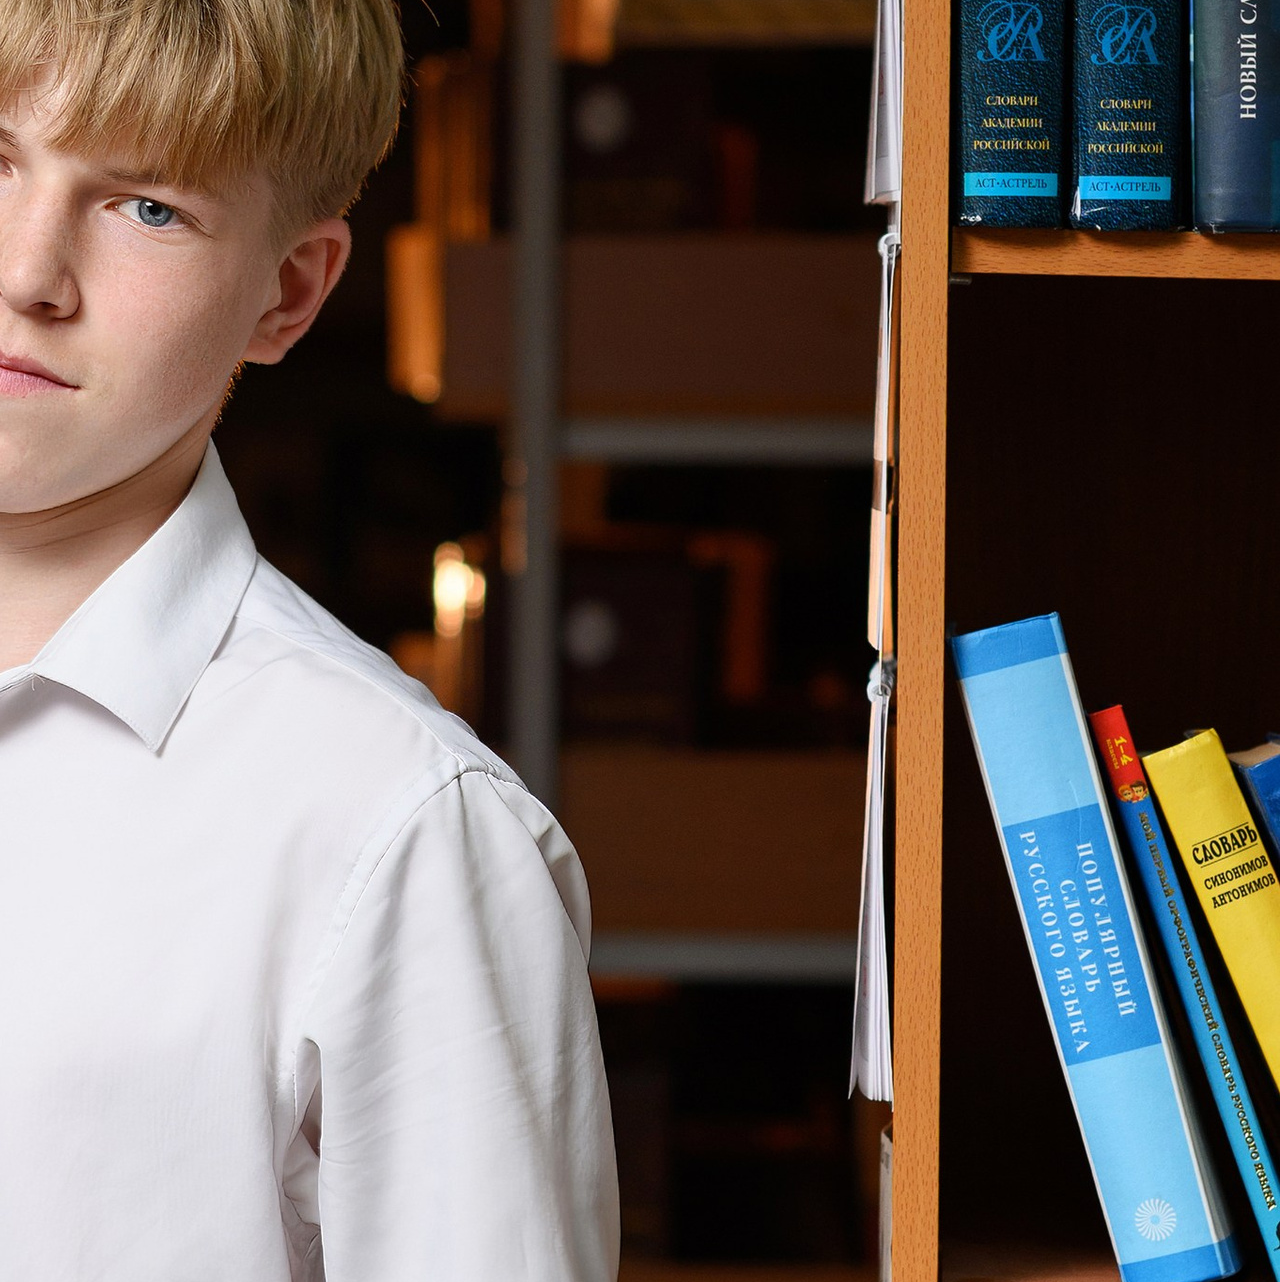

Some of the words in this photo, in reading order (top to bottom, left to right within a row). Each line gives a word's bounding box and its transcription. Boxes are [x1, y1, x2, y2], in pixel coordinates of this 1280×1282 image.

[1236, 33, 1257, 119] НОВЫЙ
[986, 95, 1038, 106] СЛОВАРИ
[1100, 99, 1152, 109] СЛОВАРИ
[981, 118, 1043, 129] АКАДЕМИИ
[1096, 121, 1156, 132] АКАДЕМИИ
[973, 138, 1050, 150] РОССИЙСКОЙ
[1088, 141, 1163, 154] РОССИЙСКОЙ
[1192, 825, 1258, 865] СЛОВАРЬ
[1204, 854, 1269, 890] СИНОНИМОВ
[1212, 873, 1276, 909] АНТОНИМОВ
[1019, 831, 1067, 958] РУССКОГО
[1055, 967, 1091, 1054] ЯЗЫКА
[1060, 879, 1102, 993] СЛОВАРЬ
[1076, 841, 1139, 1018] ПОПУЛЯРНЫЙ
[1148, 843, 1175, 898] ПЕРВЫЙ
[1167, 900, 1220, 1032] ОРФОГРАФИЧЕСКИЙ
[1211, 1033, 1237, 1094] СЛОВАРЬ
[1231, 1093, 1261, 1161] РУССКОГО
[1253, 1162, 1277, 1211] ЯЗЫКА
